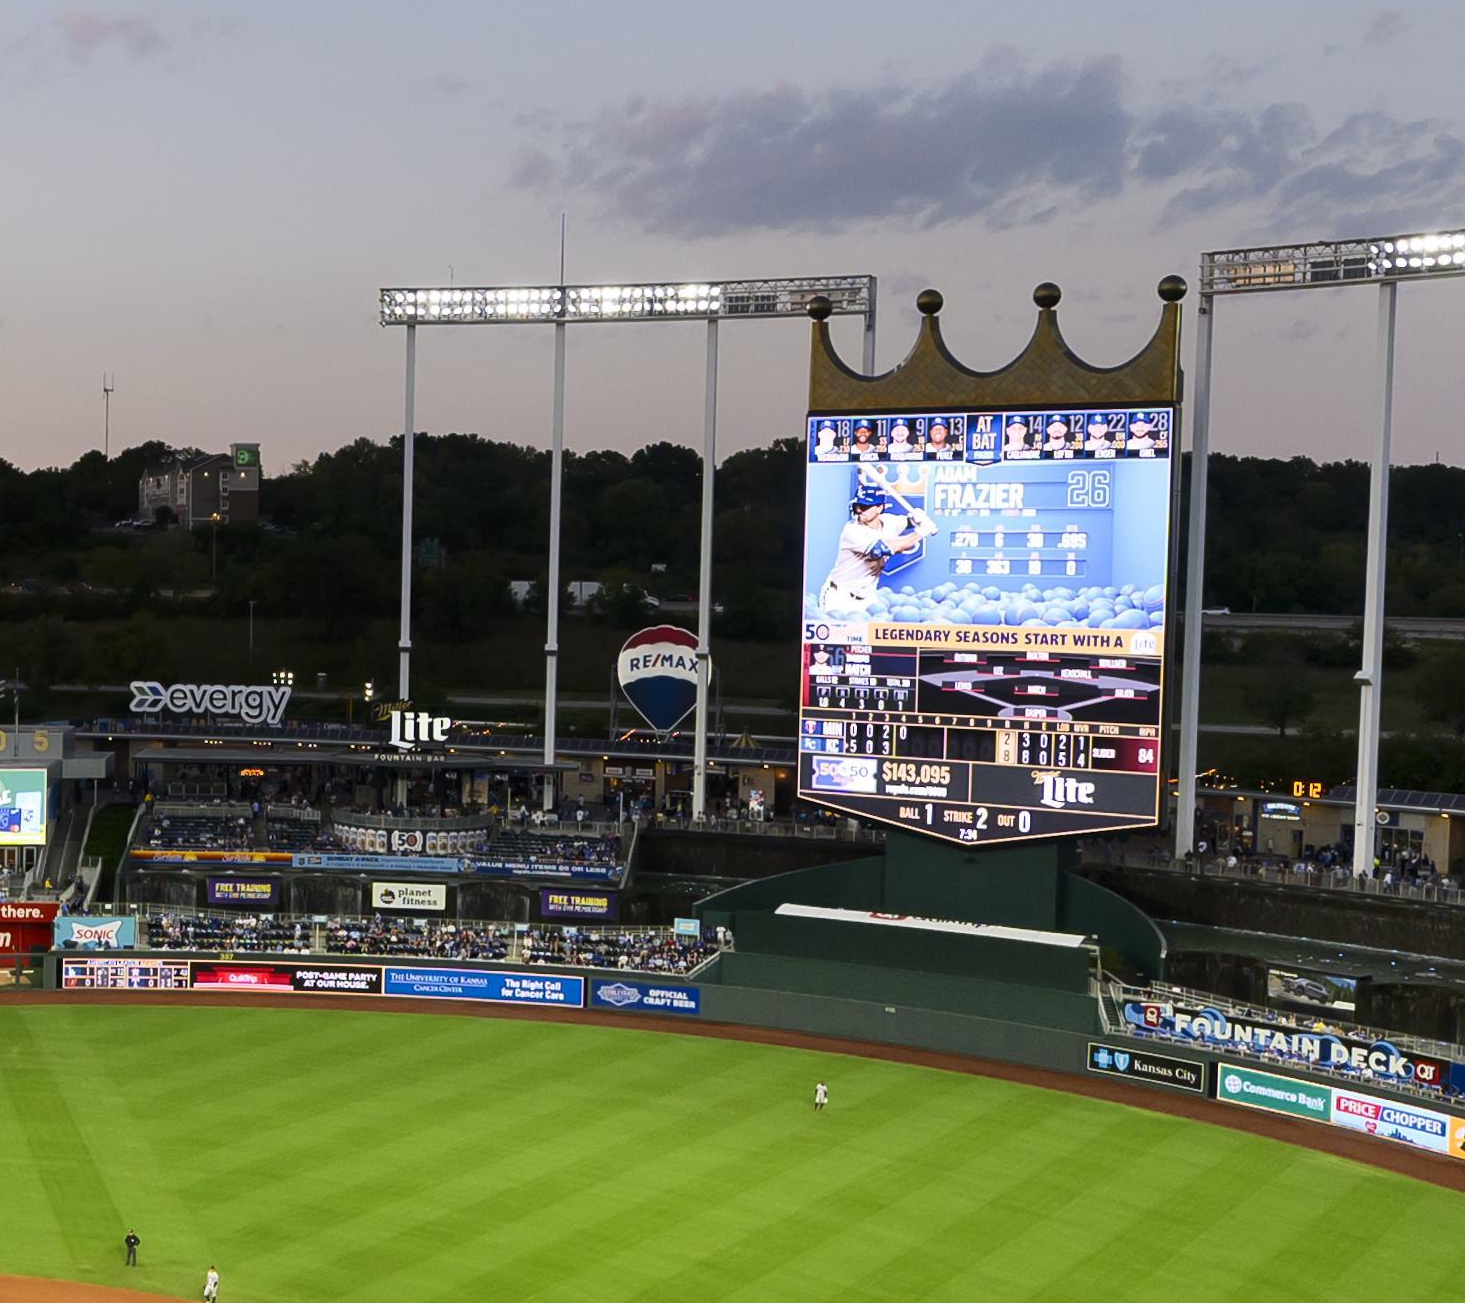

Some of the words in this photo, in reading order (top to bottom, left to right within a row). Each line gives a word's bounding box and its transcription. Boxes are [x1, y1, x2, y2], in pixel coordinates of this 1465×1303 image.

[977, 416, 993, 432] AT
[973, 433, 996, 449] BAT
[935, 467, 976, 482] ADAM
[935, 484, 1024, 508] FRAZIER
[1068, 471, 1109, 507] 26
[875, 629, 950, 642] LEGENDARY
[955, 631, 1018, 644] SEASONS
[1025, 633, 1067, 645] START
[1073, 634, 1110, 647] WITH
[1114, 636, 1123, 648] A
[630, 654, 698, 674] RE/MAX
[167, 684, 291, 723] evergy
[388, 711, 451, 748] Lite
[823, 722, 842, 736] MIN
[826, 739, 839, 752] KC
[374, 754, 422, 762] FOUNTAIN
[1138, 749, 1154, 763] 84
[883, 762, 950, 784] $143,095
[1041, 776, 1095, 808] Lite
[899, 807, 919, 819] BALL
[944, 810, 972, 823] STRIKE
[998, 815, 1015, 826] OUT
[215, 883, 234, 892] FREE
[398, 888, 431, 899] planet
[403, 896, 438, 906] fitness
[549, 896, 568, 905] FREE
[571, 897, 607, 907] TRAINING
[1, 905, 44, 918] there.
[75, 929, 114, 940] SONIC
[297, 971, 347, 981] POST-GAME
[349, 973, 377, 982] PARTY
[405, 974, 448, 983] UNIVERSITY
[460, 976, 487, 985] KANSAS
[522, 980, 543, 990] Right
[649, 990, 688, 999] OFFICIAL
[643, 997, 670, 1007] CRAFT
[674, 999, 695, 1009] BEER
[1175, 1013, 1319, 1061] FOUNTAIN
[1331, 1043, 1408, 1076] DECK
[1134, 1060, 1172, 1076] Kansas
[1176, 1068, 1197, 1084] City
[1417, 1064, 1435, 1080] QT
[1243, 1081, 1296, 1102] Commerce
[1298, 1093, 1326, 1107] Bank
[1340, 1098, 1376, 1117] PRICE
[1383, 1110, 1442, 1134] CHOPPER
